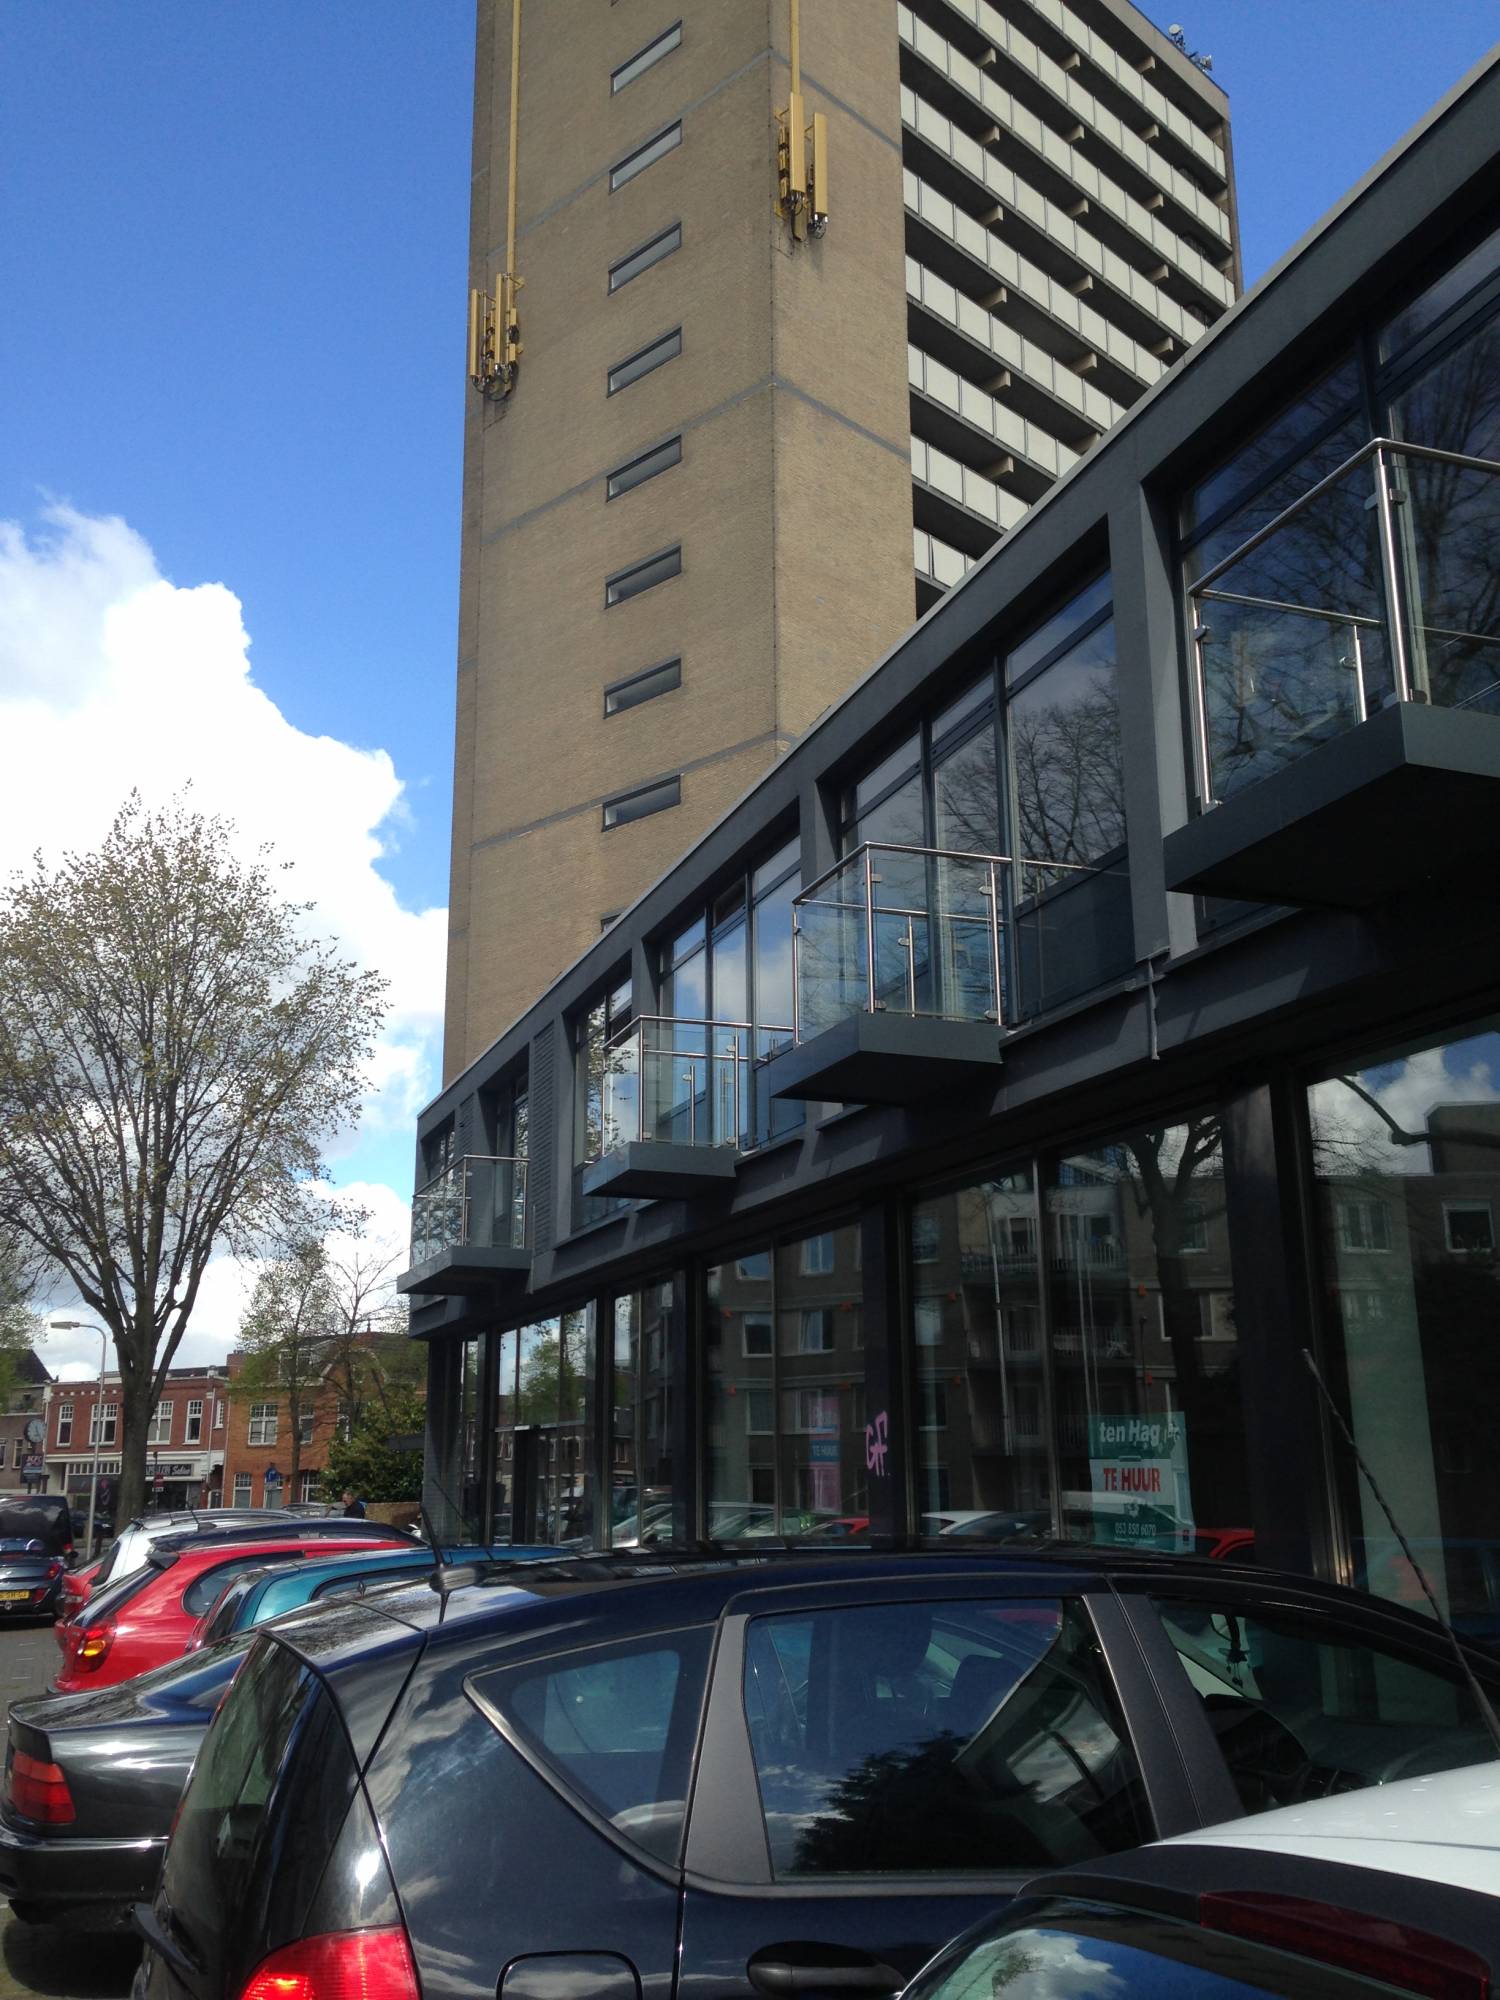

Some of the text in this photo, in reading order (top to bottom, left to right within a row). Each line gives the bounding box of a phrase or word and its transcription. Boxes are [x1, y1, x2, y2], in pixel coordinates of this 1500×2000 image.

[1099, 1419, 1160, 1447] ten Hag
[1103, 1467, 1161, 1493] TE HUUR
[1114, 1521, 1127, 1535] 053
